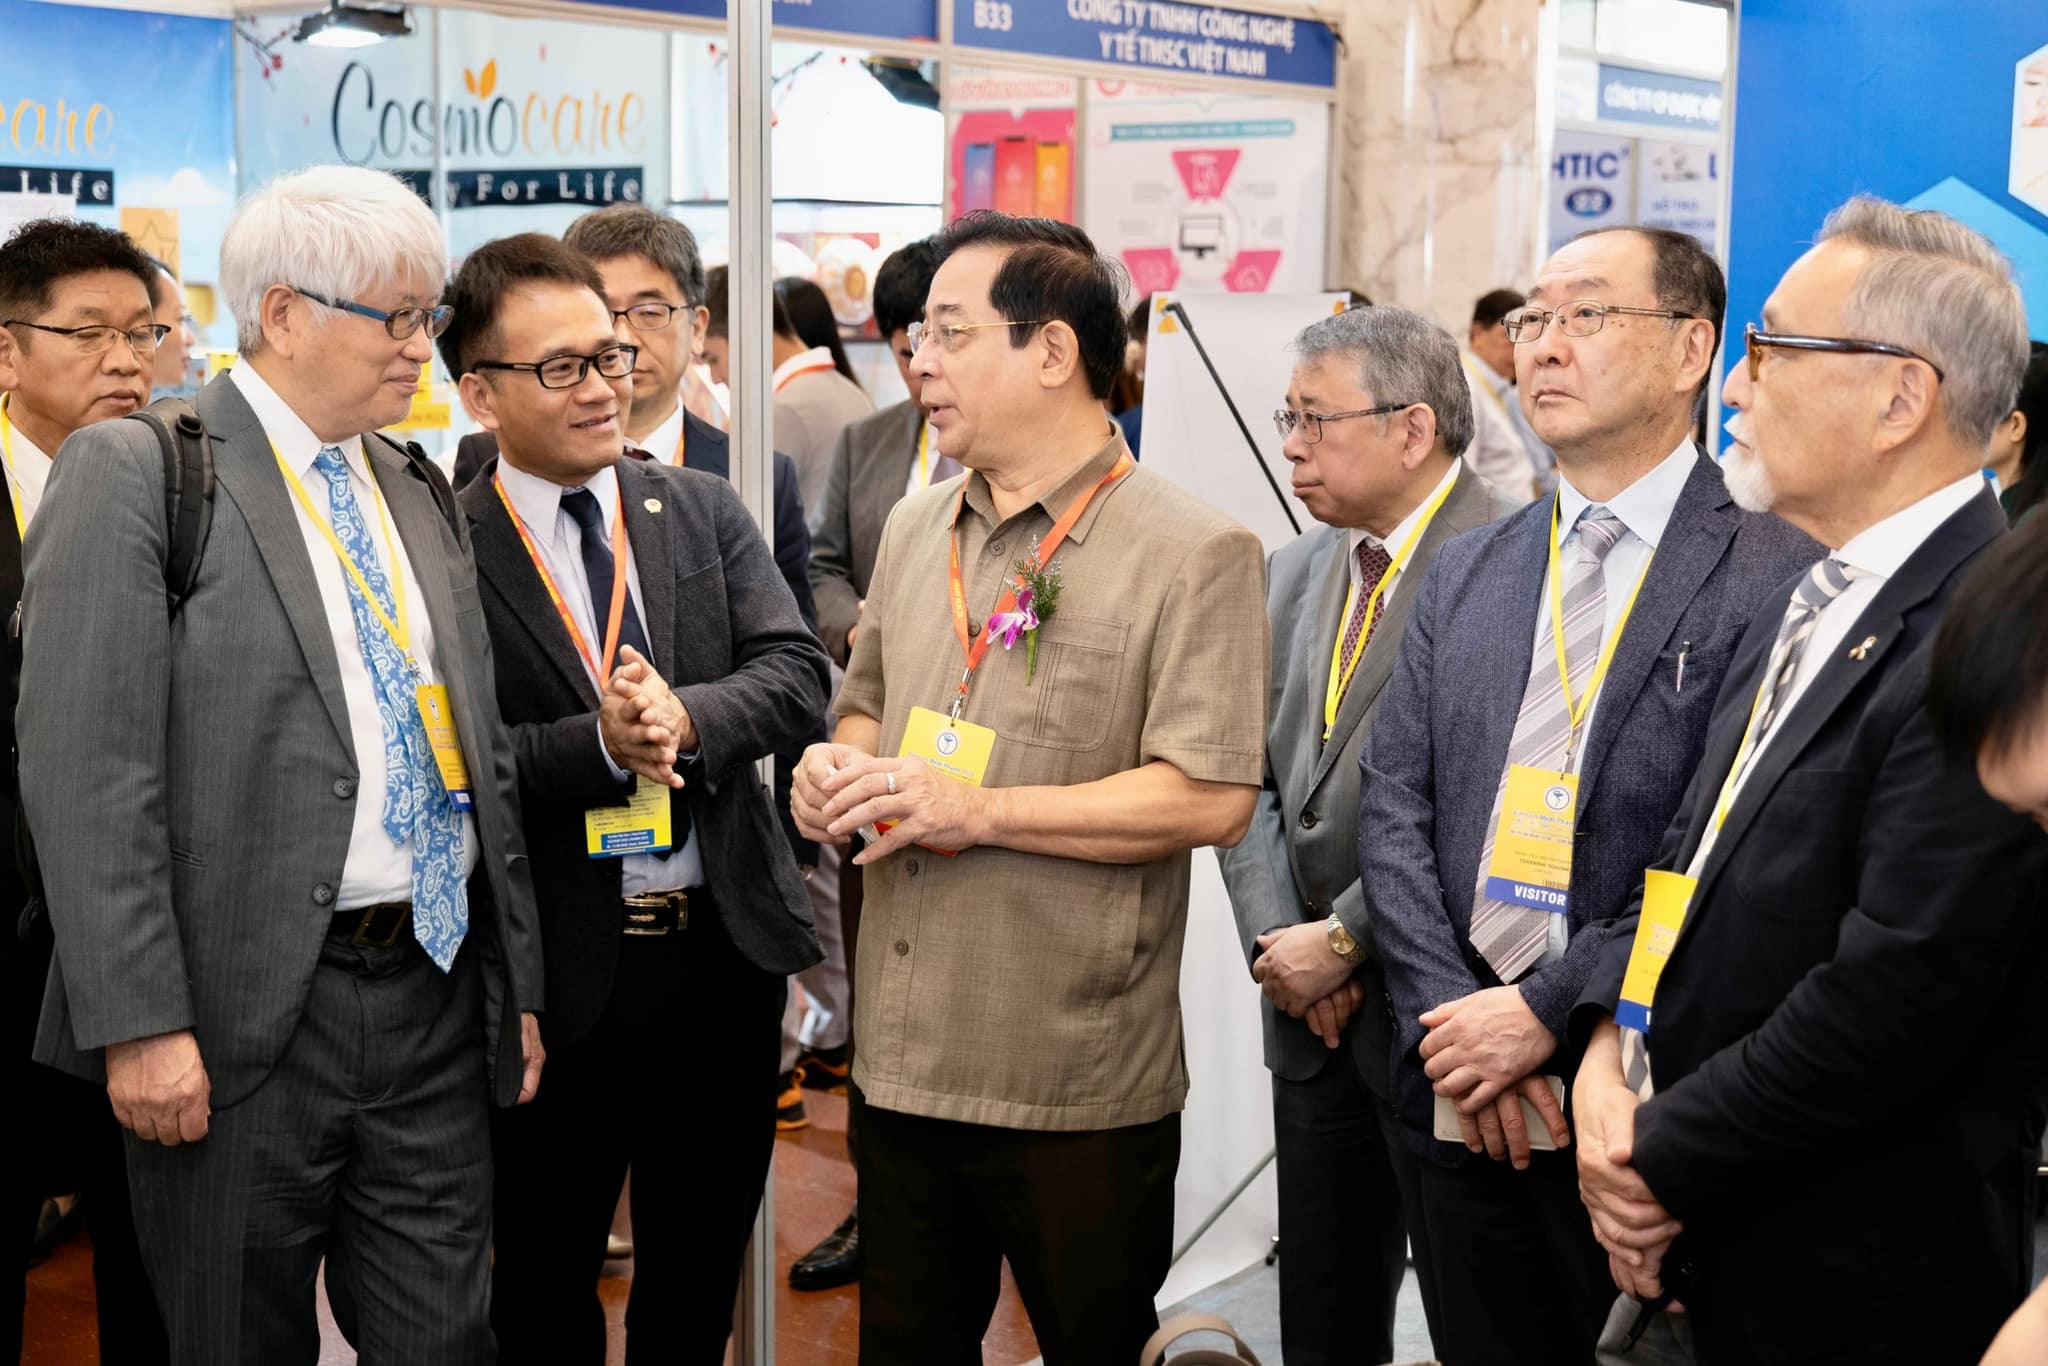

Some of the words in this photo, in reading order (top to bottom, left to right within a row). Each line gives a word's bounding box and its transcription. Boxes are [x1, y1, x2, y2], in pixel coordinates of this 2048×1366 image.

[973, 0, 1013, 31] B33
[1124, 0, 1148, 28] TY
[1149, 4, 1199, 35] TNHH
[1200, 8, 1248, 41] CÔNG
[1249, 15, 1295, 54] NGHỆ
[1099, 31, 1113, 60] Y
[1114, 28, 1138, 62] TẾ
[1187, 38, 1225, 75] VIỆT
[1226, 46, 1267, 76] NAM
[332, 61, 645, 166] Cosmocare
[476, 173, 540, 200] For
[556, 170, 642, 201] Life
[1513, 885, 1567, 907] VISITOR
